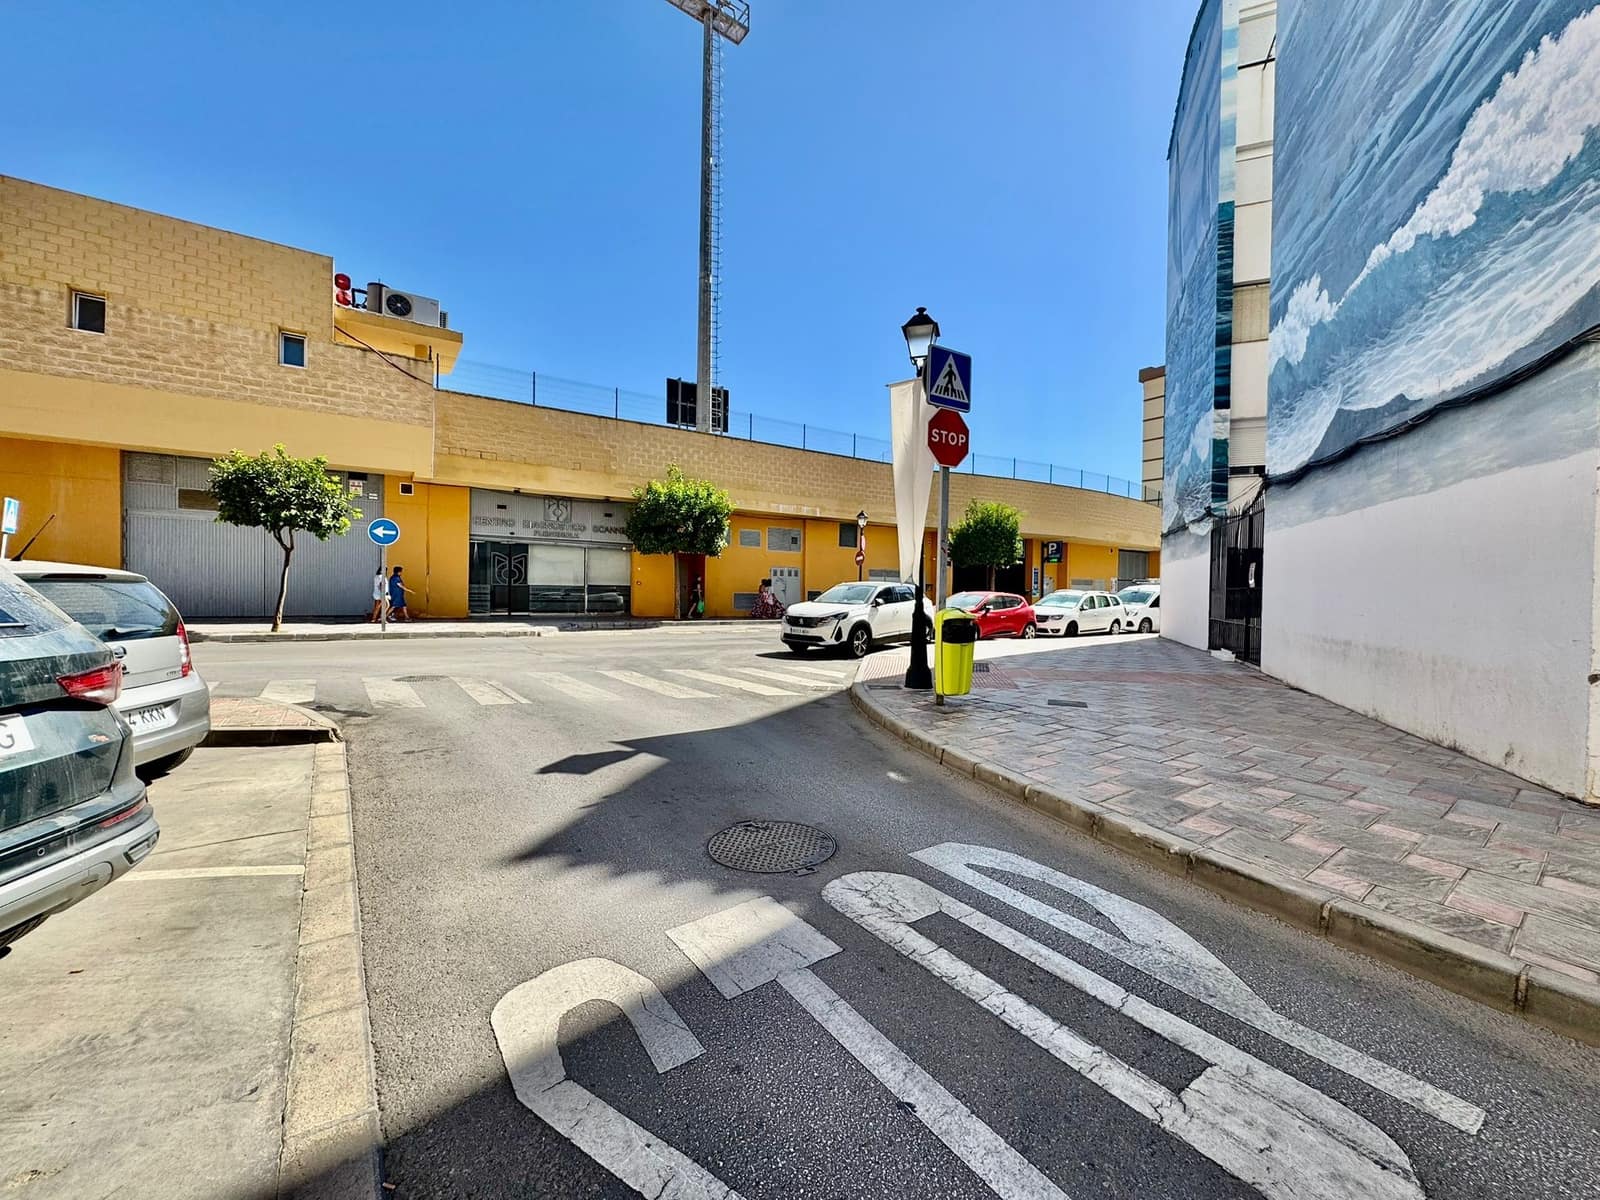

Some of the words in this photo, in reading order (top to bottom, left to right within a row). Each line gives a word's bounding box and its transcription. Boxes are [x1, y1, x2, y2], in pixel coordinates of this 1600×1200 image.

[931, 428, 966, 447] STOP
[474, 516, 515, 528] CENTRO
[592, 525, 626, 535] SCANNE
[1048, 543, 1057, 554] P
[139, 705, 167, 724] KKN
